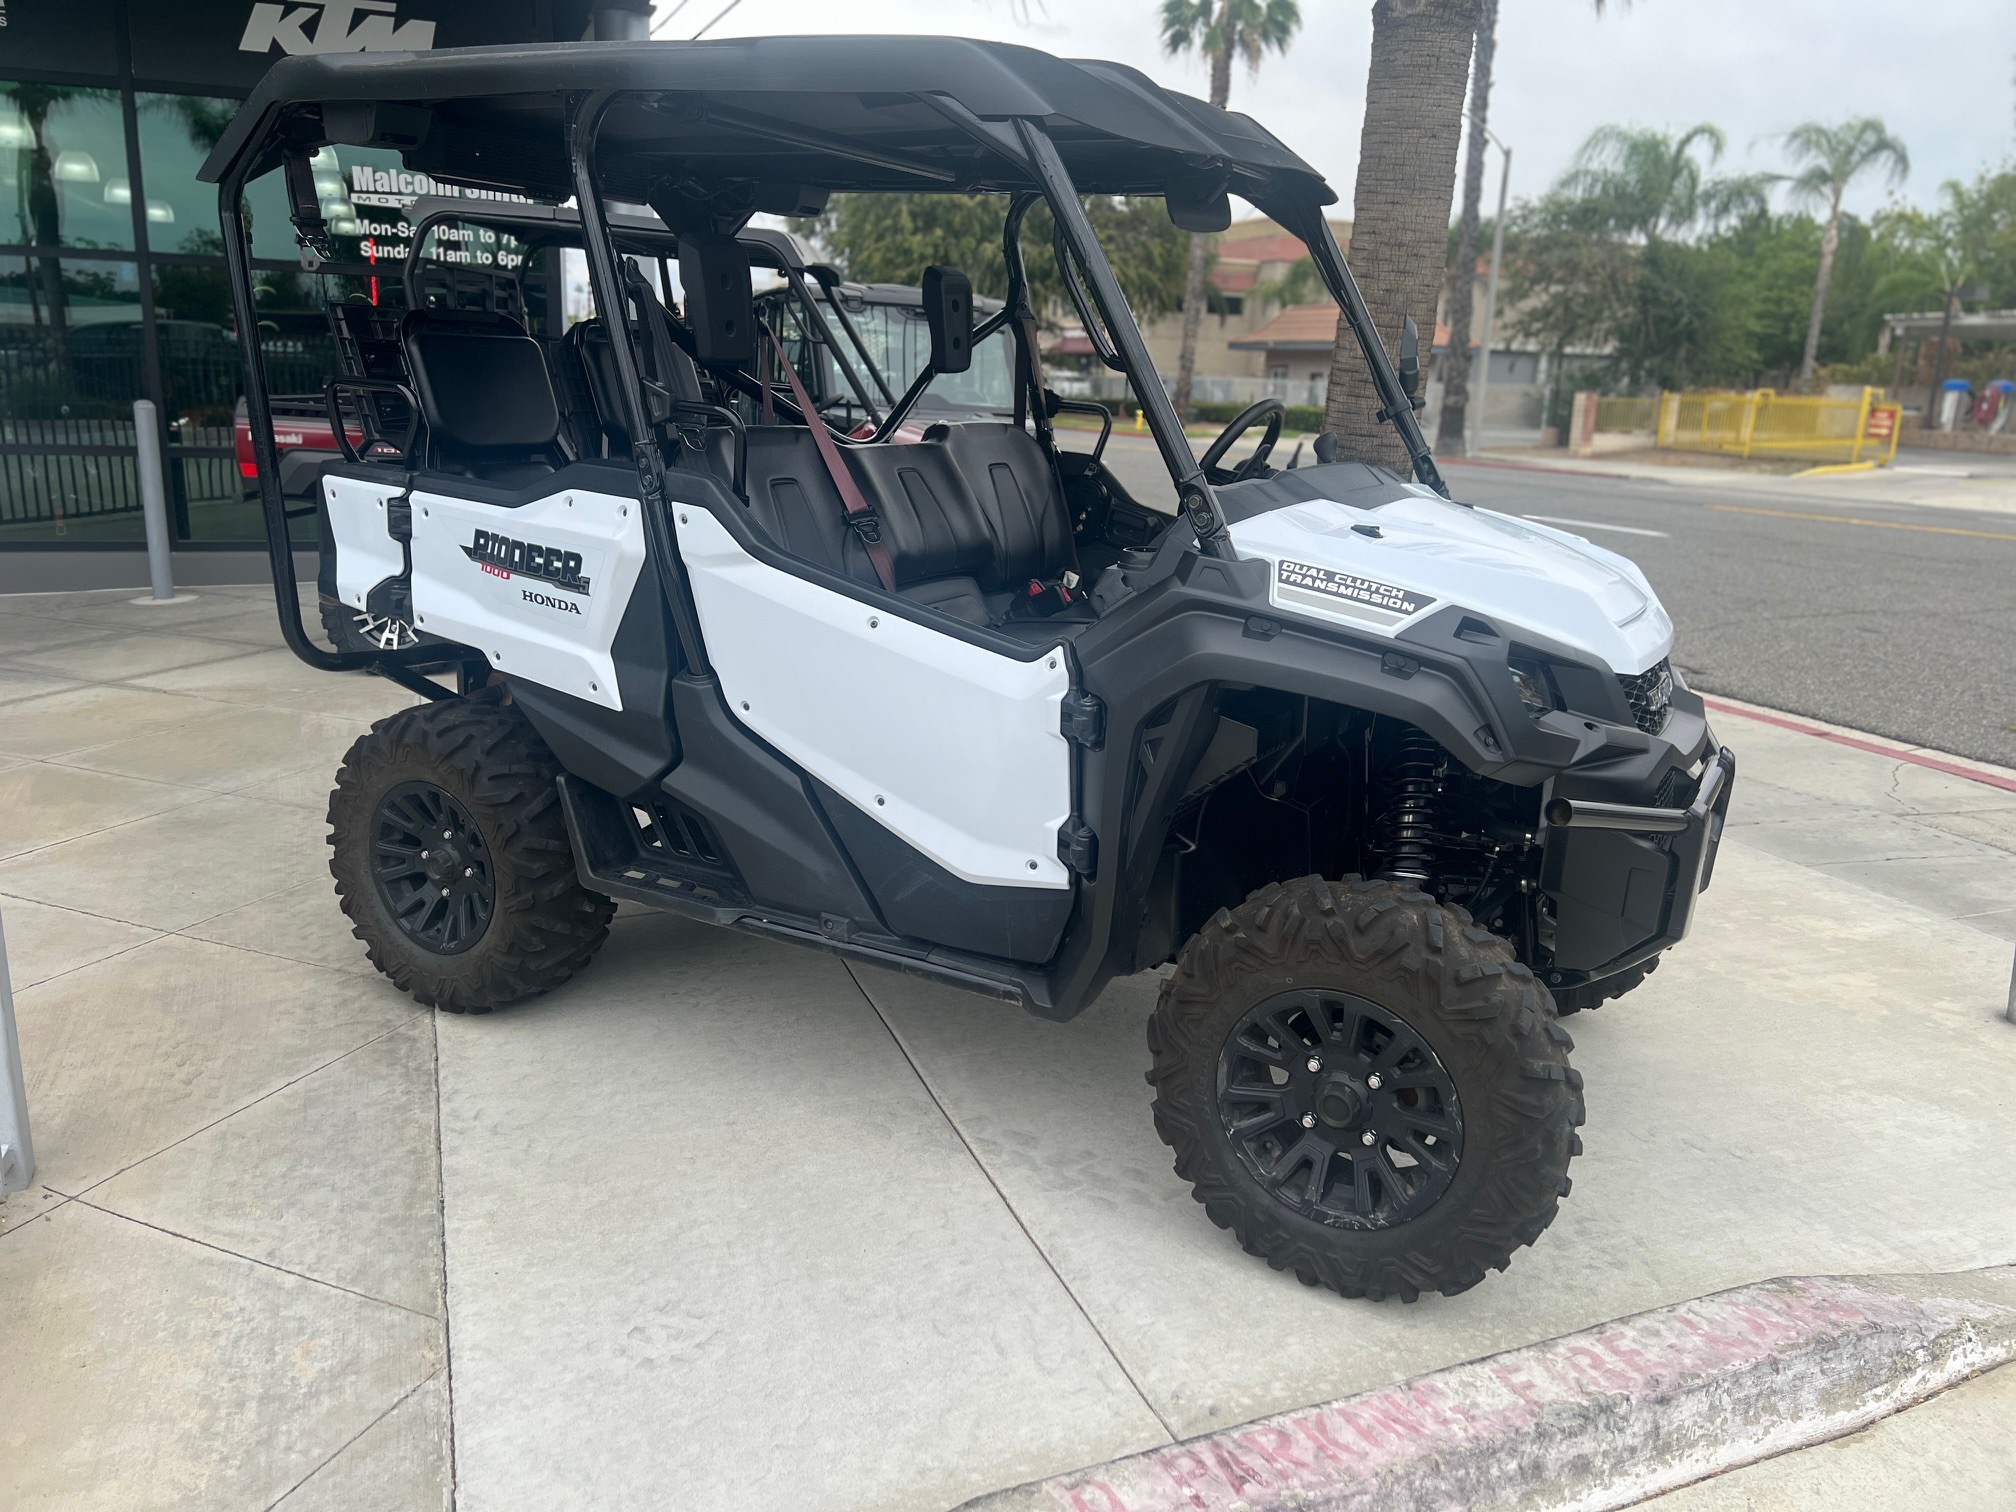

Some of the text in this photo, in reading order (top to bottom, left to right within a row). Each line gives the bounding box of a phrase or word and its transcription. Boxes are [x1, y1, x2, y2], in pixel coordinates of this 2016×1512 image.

[239, 0, 437, 55] KTM
[432, 224, 474, 242] 10am
[479, 229, 497, 243] to
[429, 246, 471, 263] 11am
[476, 250, 494, 264] to
[471, 527, 583, 584] PIONEER
[480, 562, 511, 581] 1000
[1280, 570, 1416, 612] TRANSMISSION
[1281, 560, 1405, 599] DUAL CLUTCH
[521, 589, 582, 615] HONDA
